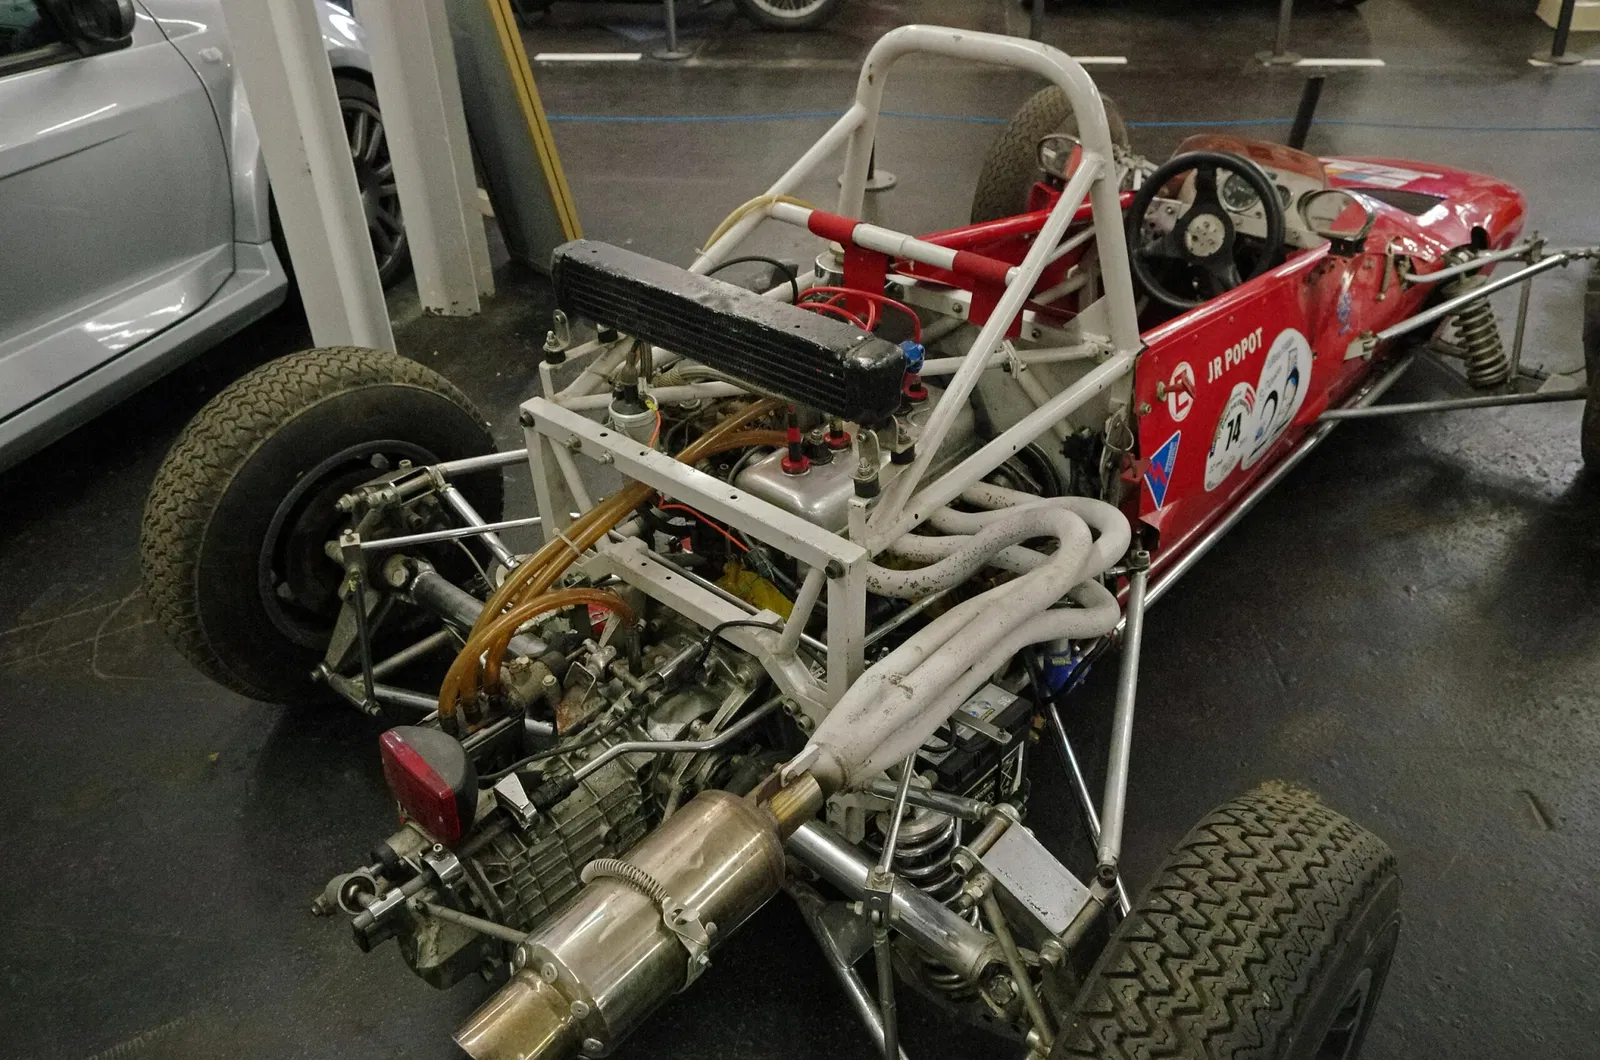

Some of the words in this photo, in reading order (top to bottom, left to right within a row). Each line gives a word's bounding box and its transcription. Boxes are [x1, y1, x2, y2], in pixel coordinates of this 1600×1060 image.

[1208, 356, 1223, 384] JR
[1225, 327, 1263, 371] POPOT
[1225, 412, 1242, 452] 74
